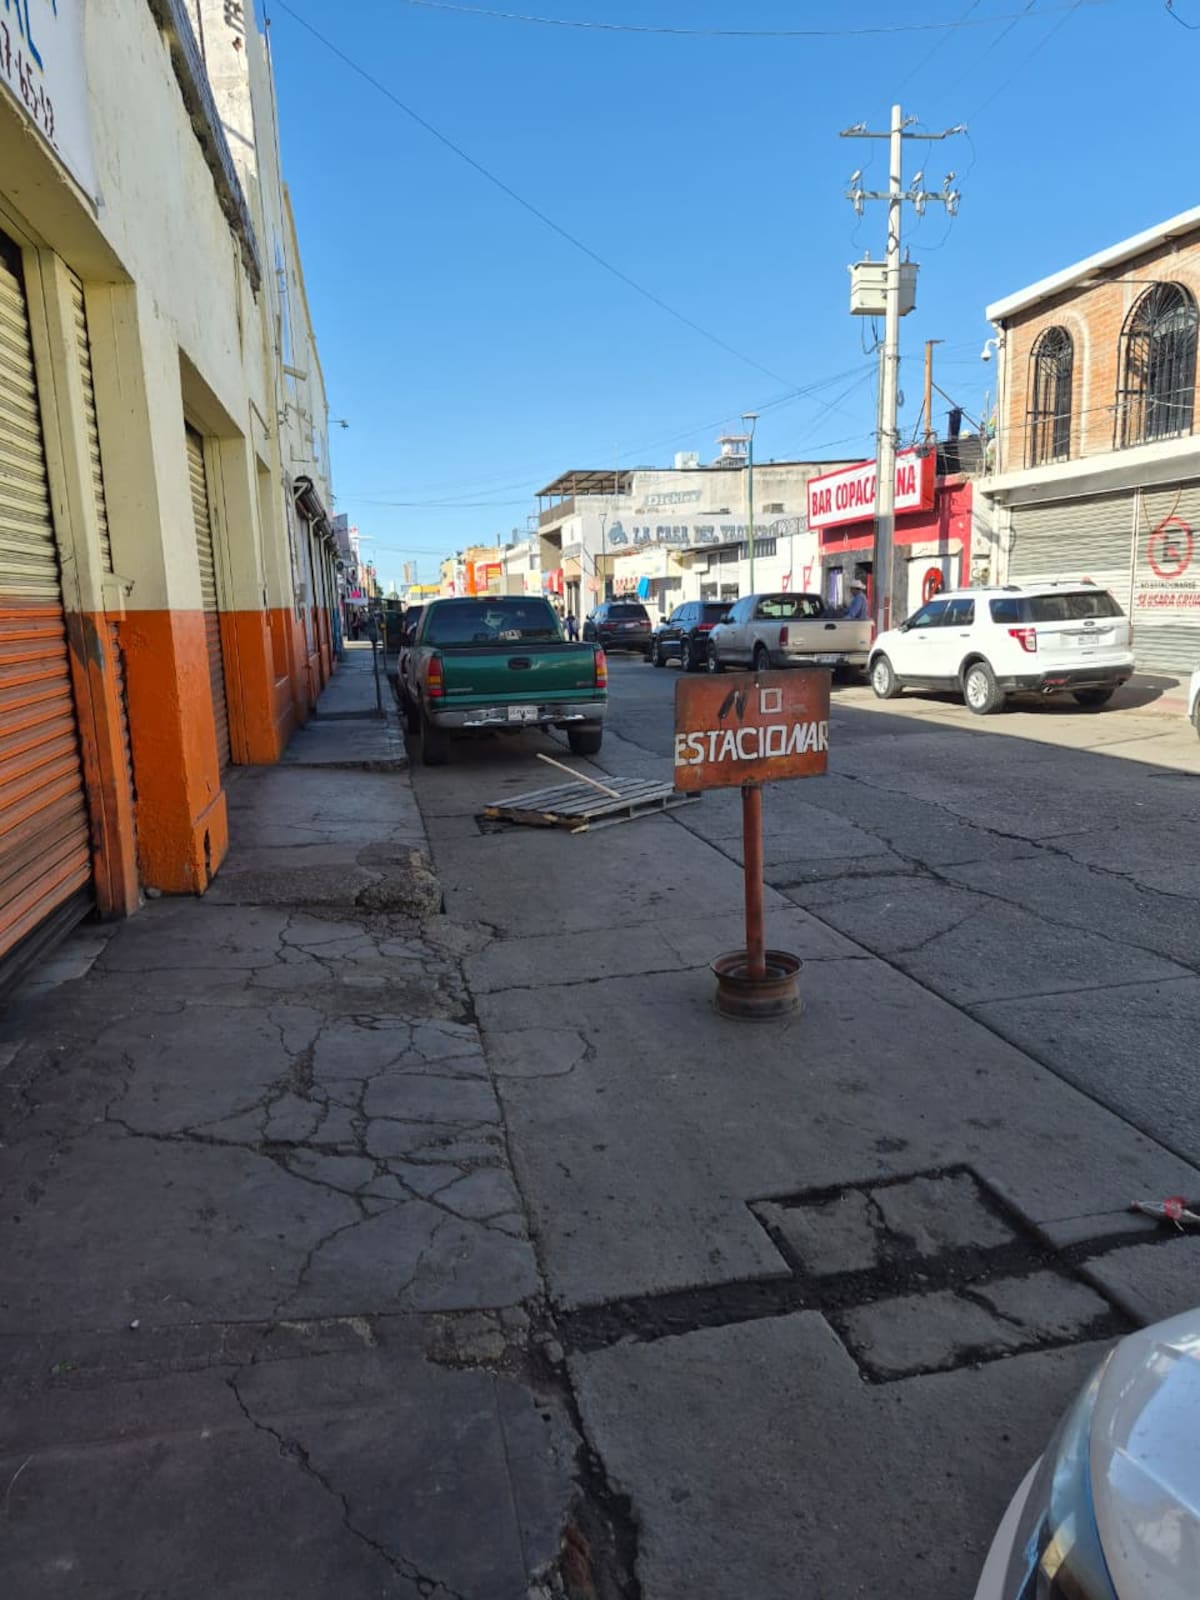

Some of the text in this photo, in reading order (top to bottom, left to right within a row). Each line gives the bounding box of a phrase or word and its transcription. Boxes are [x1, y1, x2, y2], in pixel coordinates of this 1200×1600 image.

[811, 464, 916, 516] BAR COPACANA
[633, 526, 651, 544] LA
[656, 525, 690, 544] CASA
[694, 525, 716, 544] DEL
[718, 687, 782, 722] NO
[674, 720, 829, 766] ESTACIONAR
